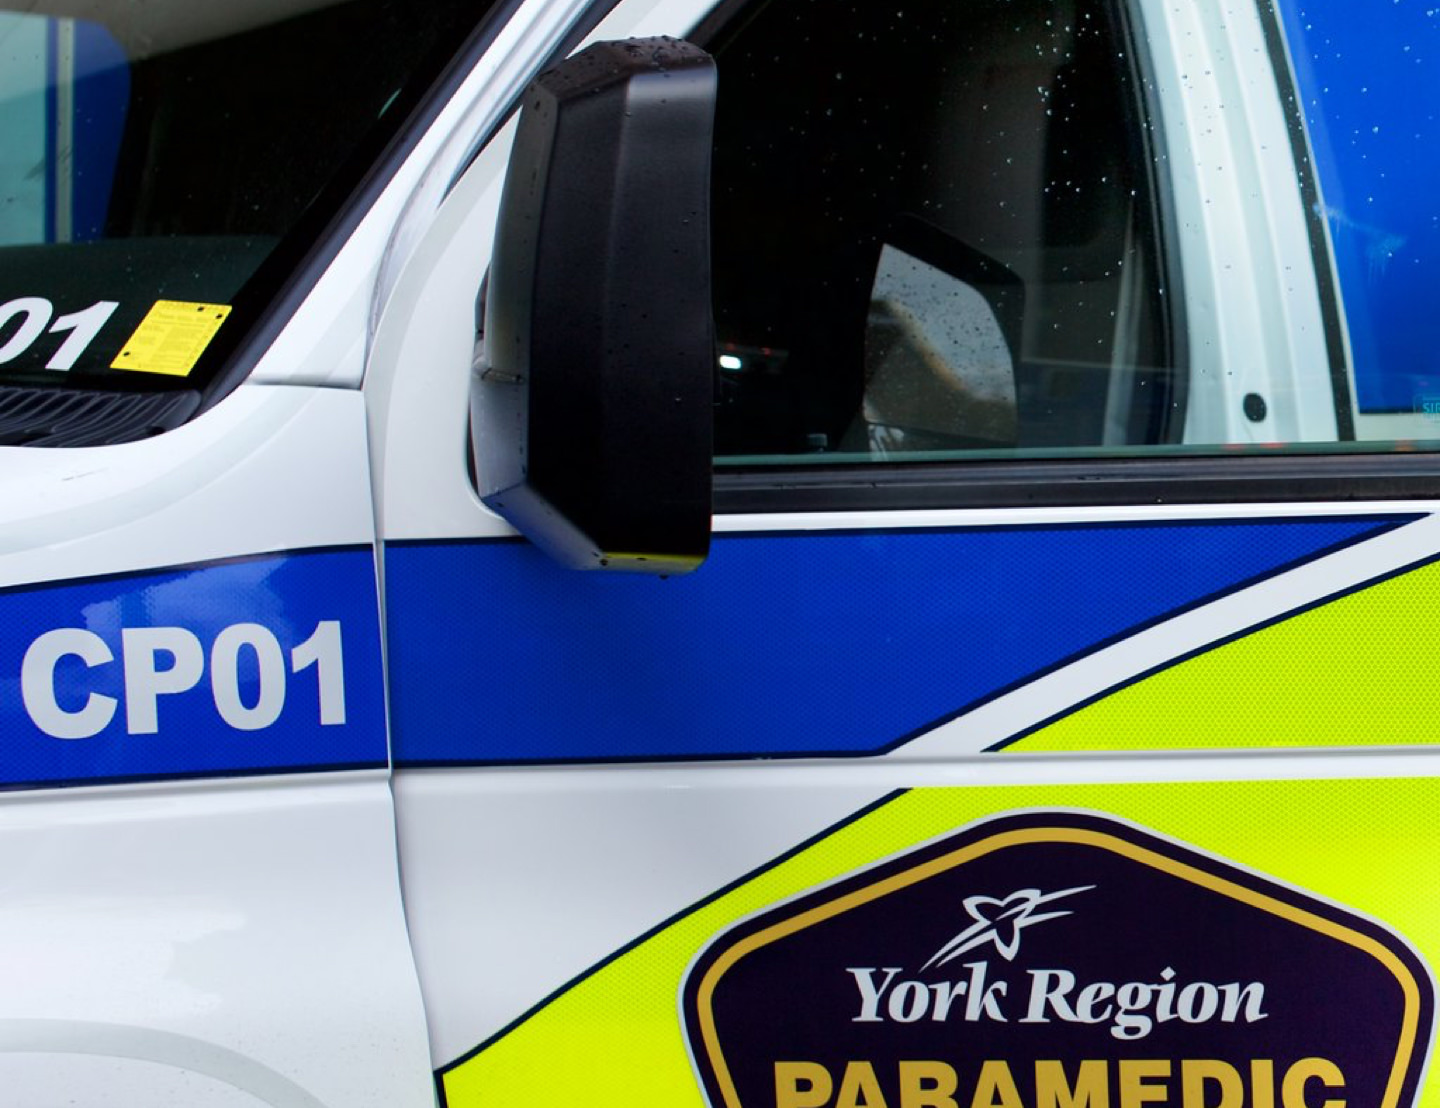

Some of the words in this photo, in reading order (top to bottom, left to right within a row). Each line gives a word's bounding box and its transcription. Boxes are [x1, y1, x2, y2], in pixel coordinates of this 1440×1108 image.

[20, 620, 347, 740] CP01
[846, 961, 1008, 1023] York
[1018, 966, 1269, 1041] Region
[774, 1056, 1347, 1108] PARAMEDIC
